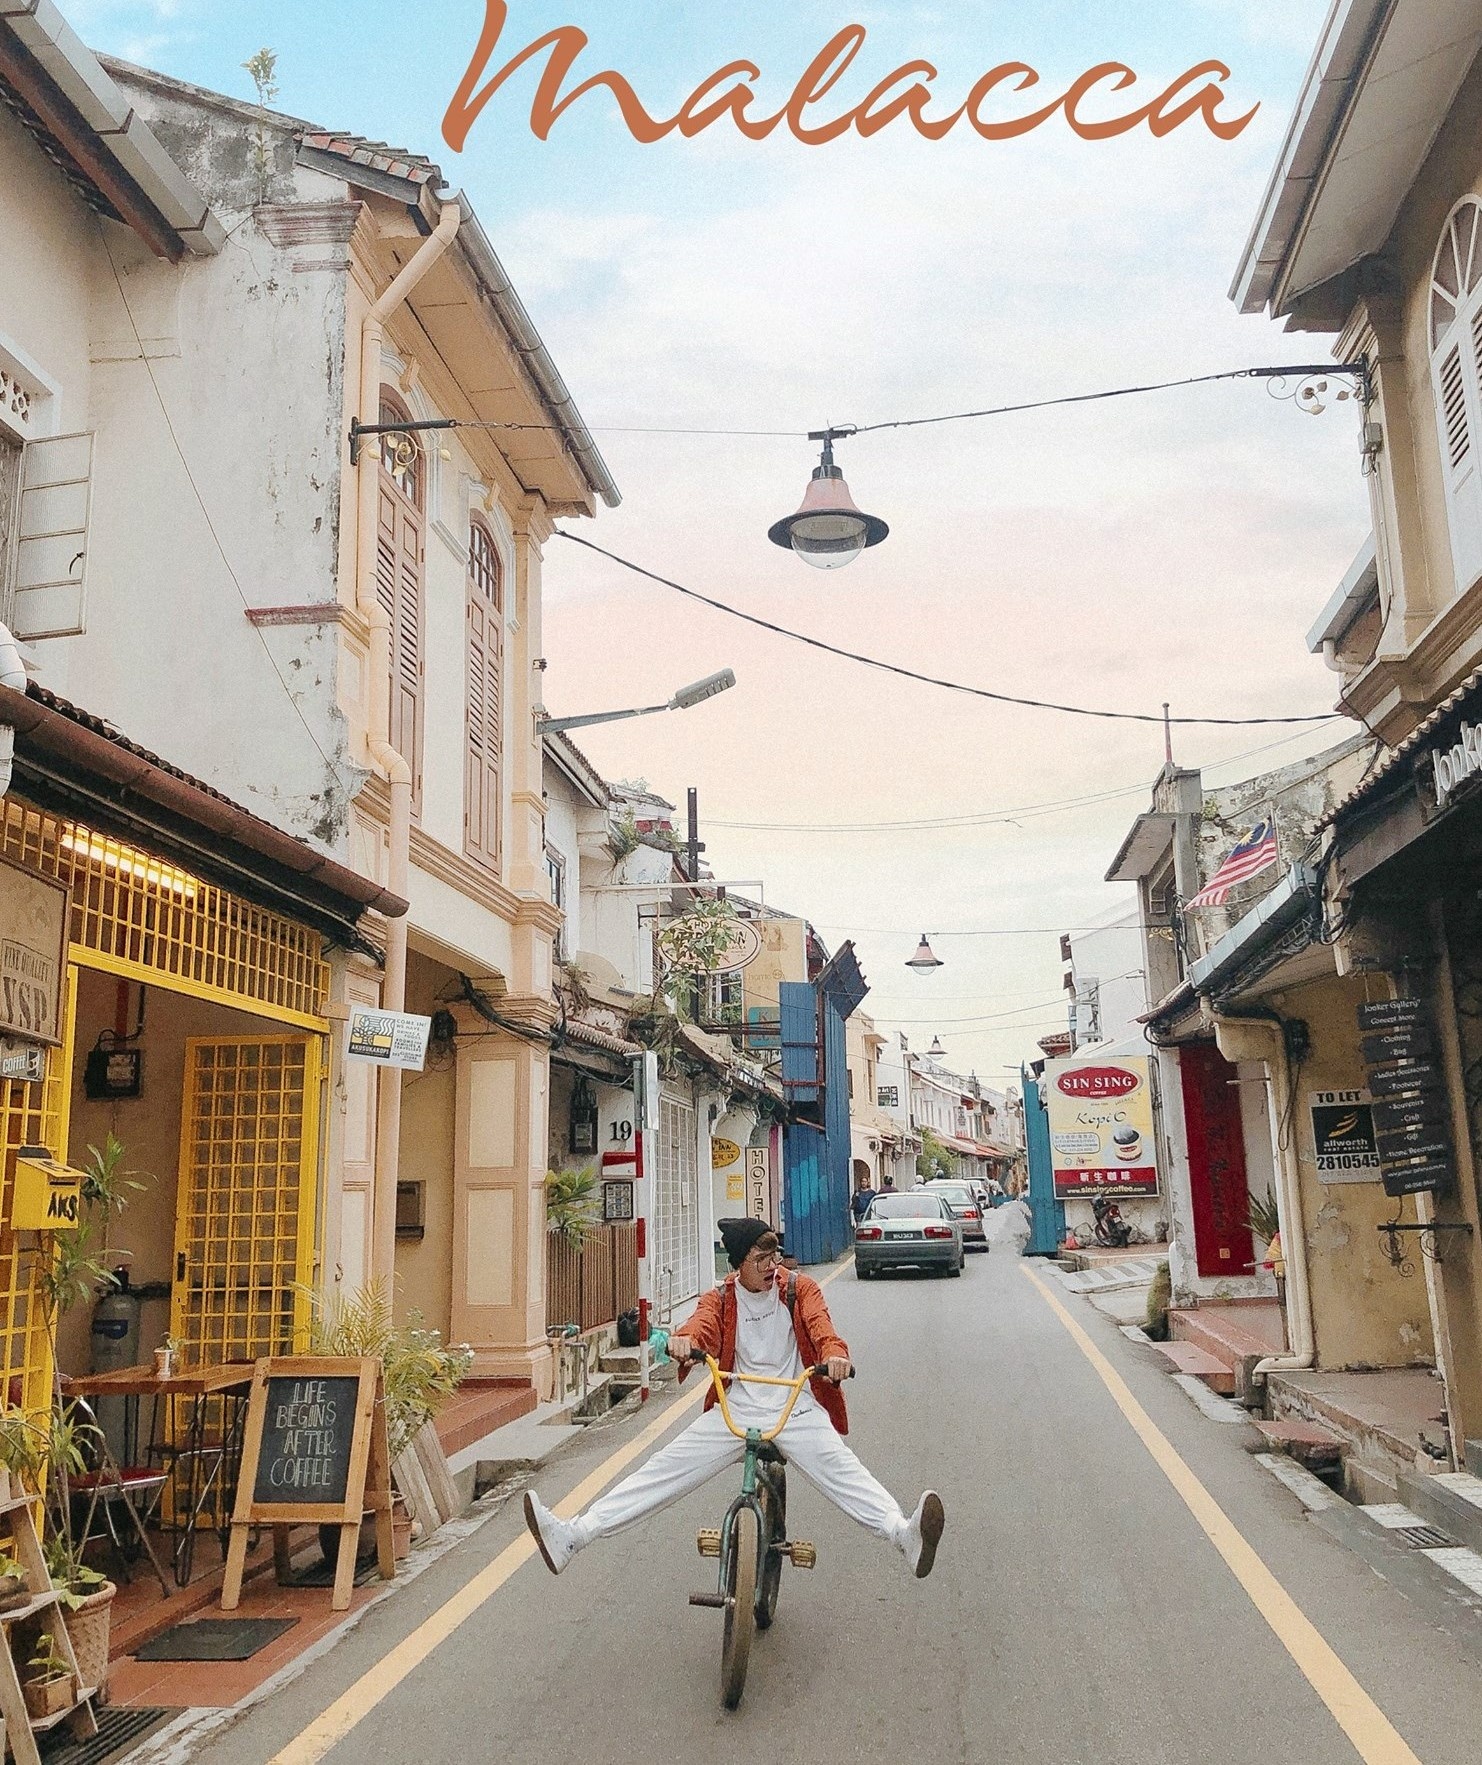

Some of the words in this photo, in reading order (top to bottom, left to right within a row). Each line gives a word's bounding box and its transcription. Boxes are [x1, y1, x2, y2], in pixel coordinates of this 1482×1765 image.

[4, 945, 21, 970] FINE
[2, 1055, 26, 1073] COFFEE
[1063, 1078, 1090, 1089] SIN
[1094, 1076, 1132, 1088] SING
[1316, 1092, 1334, 1103] TO
[1338, 1091, 1361, 1102] LET
[610, 1120, 632, 1141] 19
[1075, 1112, 1111, 1129] Kopi
[1323, 1138, 1368, 1148] allworth
[1317, 1154, 1380, 1171] 2810545
[47, 1191, 78, 1221] AKS
[292, 1380, 327, 1404] LIFE
[275, 1400, 337, 1429] BEGINS
[283, 1429, 337, 1456] AFTER
[270, 1457, 332, 1487] COFFEE
